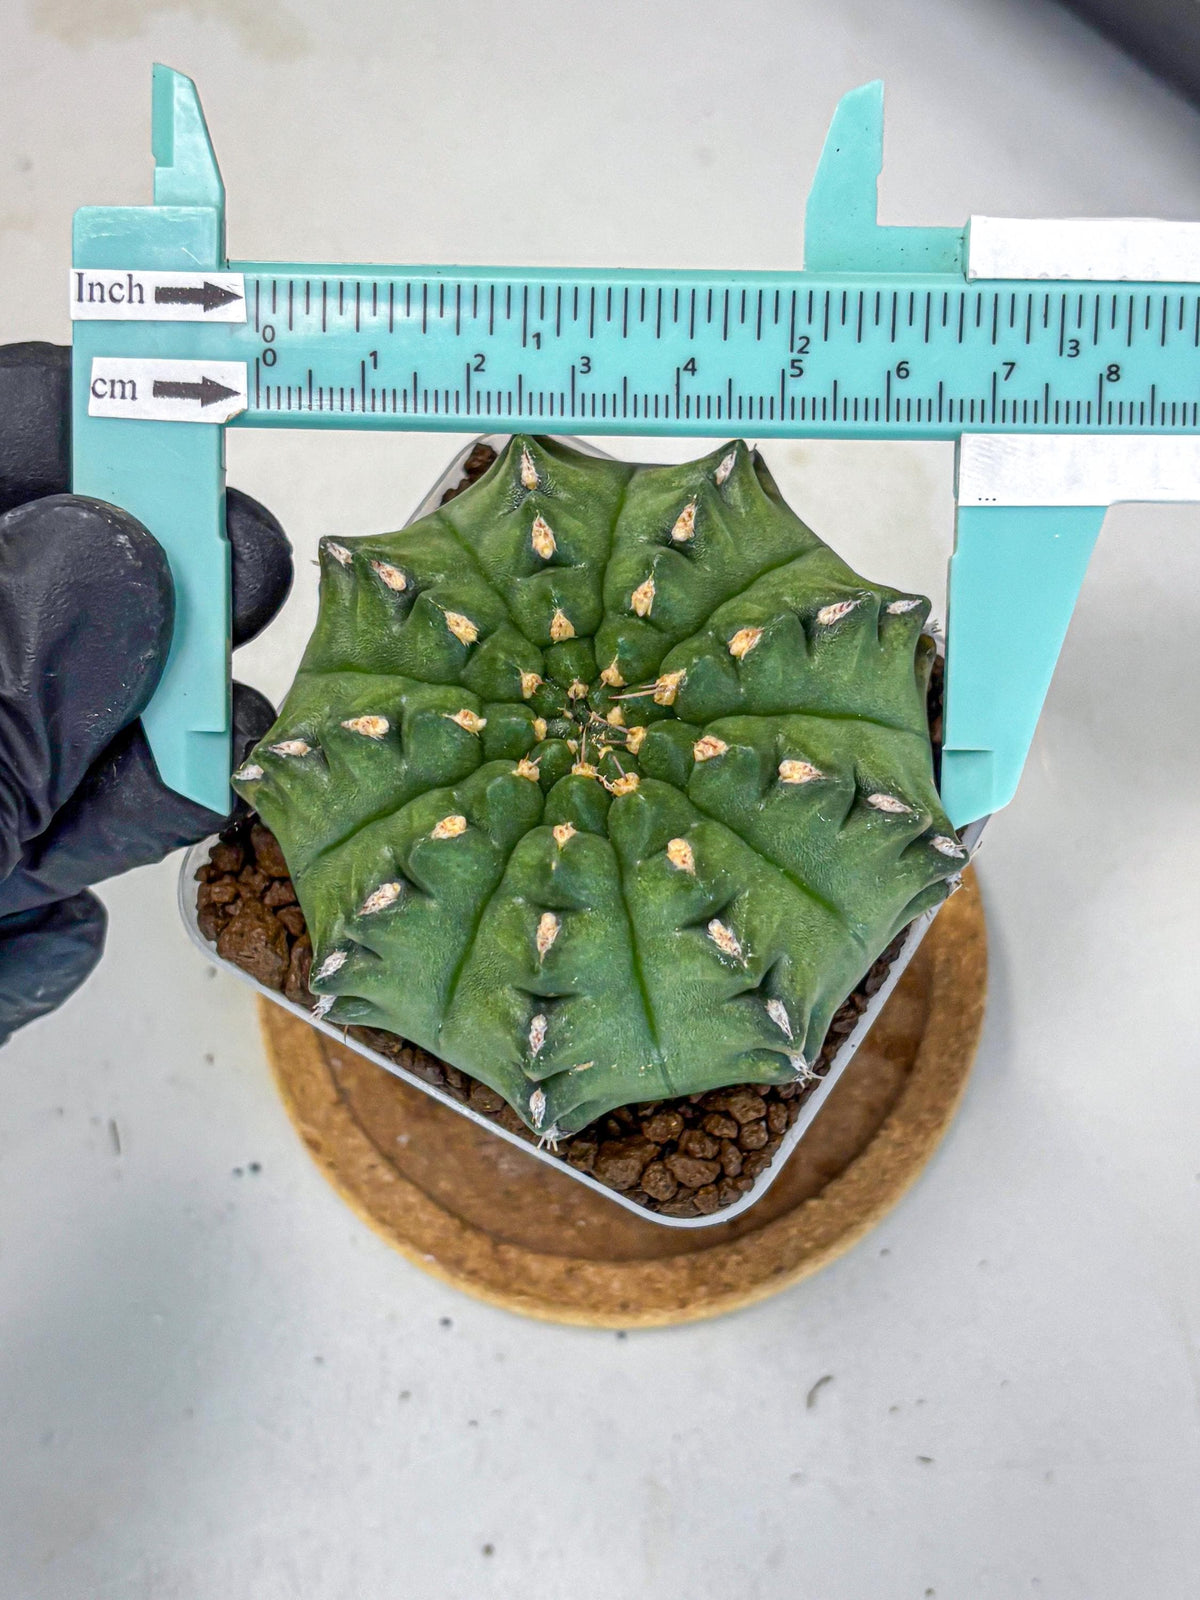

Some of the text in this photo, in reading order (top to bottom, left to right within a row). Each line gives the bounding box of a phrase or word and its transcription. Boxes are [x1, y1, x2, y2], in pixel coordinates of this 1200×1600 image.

[74, 271, 144, 305] Inch
[261, 324, 1081, 358] 0 1 2 3
[261, 348, 1121, 383] 0 1 2 3 4 5 6 7 8
[90, 376, 138, 400] cm
